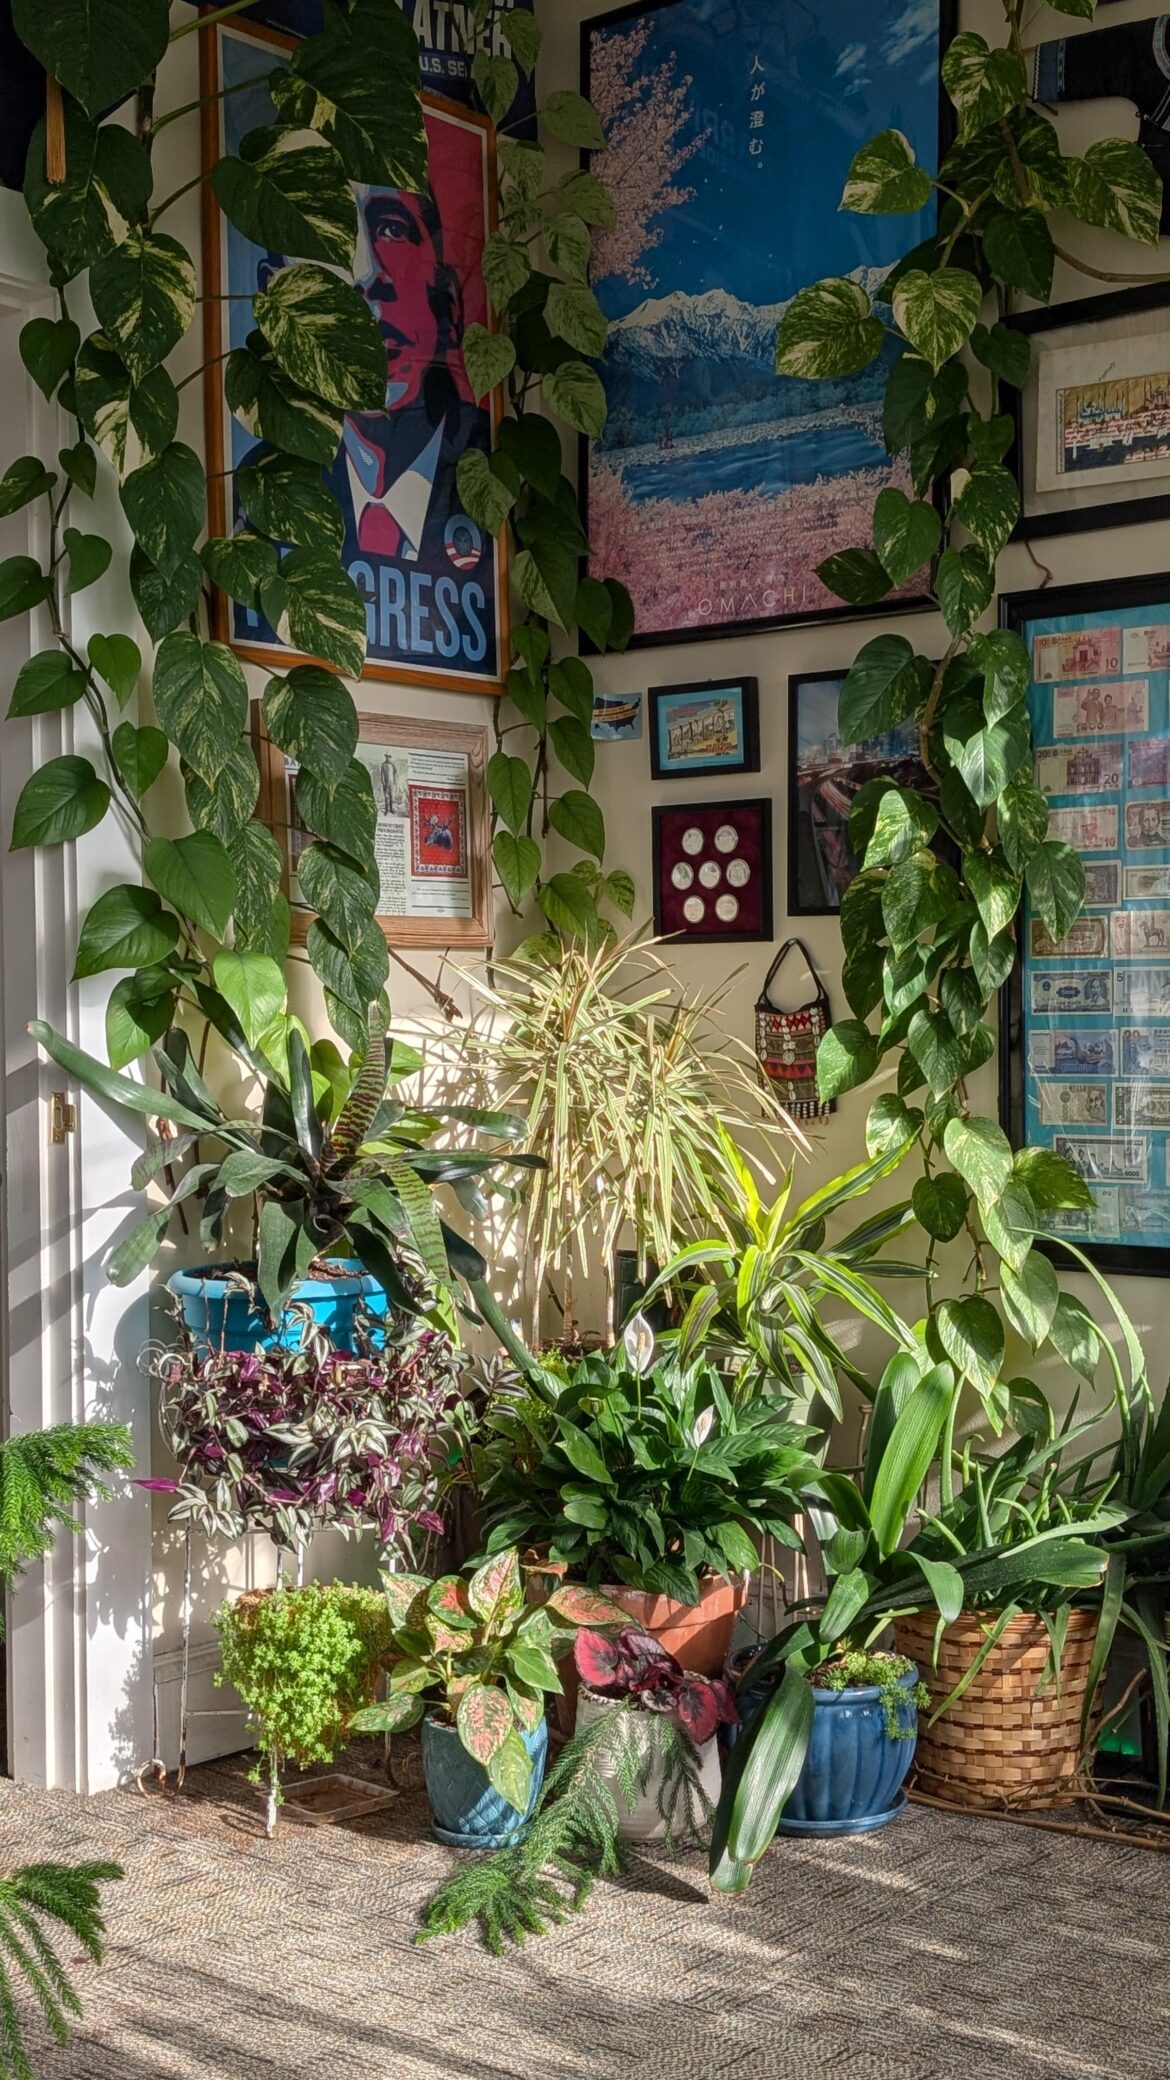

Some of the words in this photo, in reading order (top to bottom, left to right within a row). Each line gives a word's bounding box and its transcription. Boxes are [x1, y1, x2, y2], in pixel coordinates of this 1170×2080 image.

[394, 0, 512, 59] ATNER
[418, 55, 445, 74] U.S.
[447, 60, 468, 78] SE
[749, 55, 767, 169] 人が澄む。
[698, 583, 806, 616] OMACHI
[1105, 657, 1119, 669] 10
[284, 757, 300, 767] BA
[1104, 773, 1119, 785] 20
[1104, 836, 1116, 847] 10
